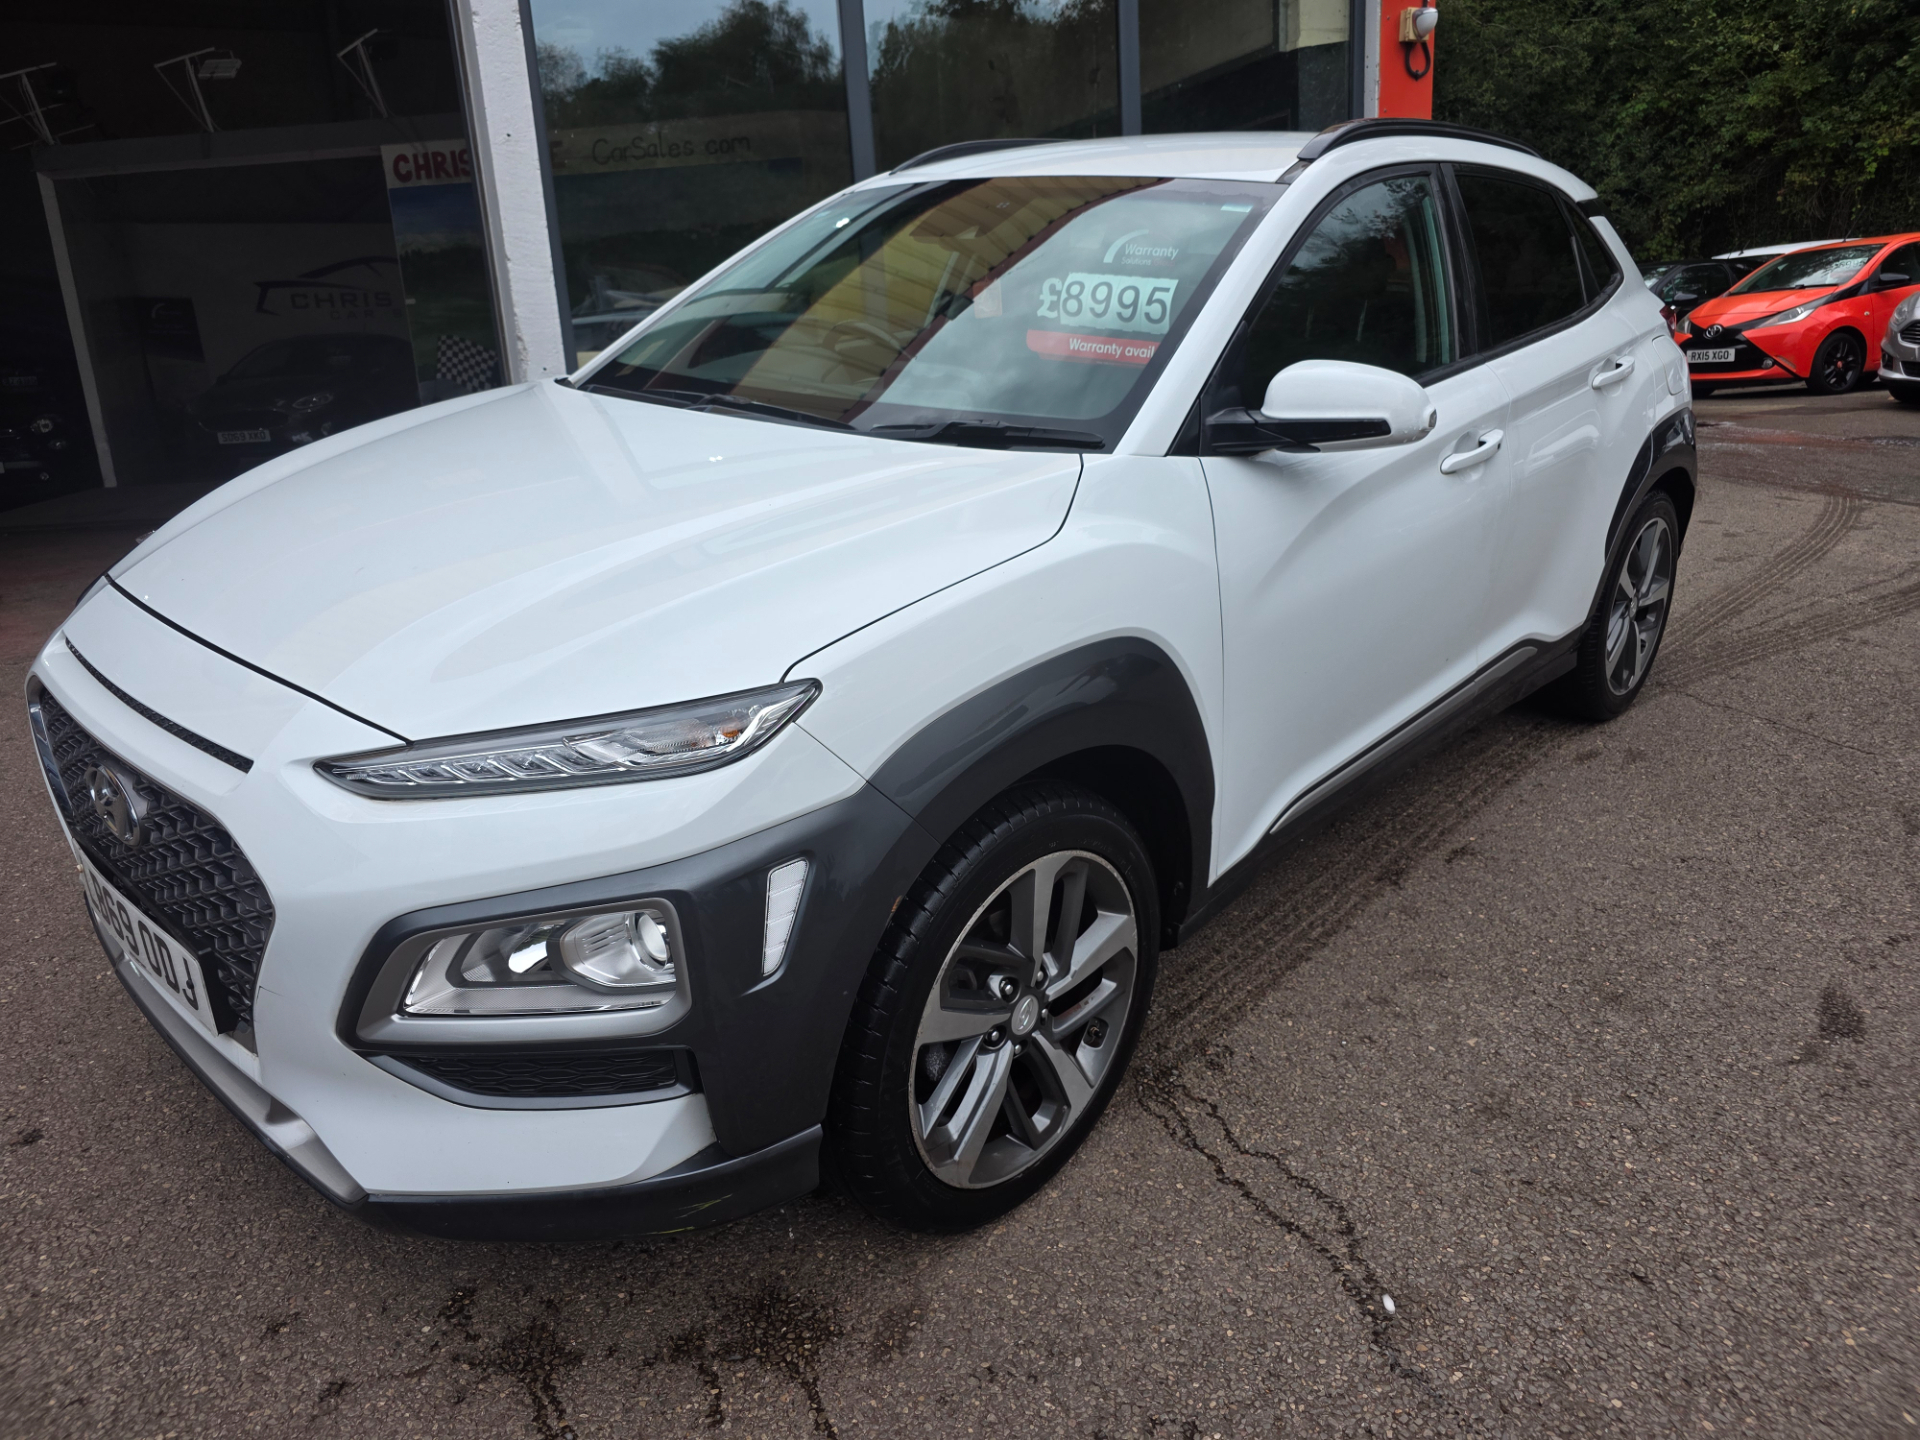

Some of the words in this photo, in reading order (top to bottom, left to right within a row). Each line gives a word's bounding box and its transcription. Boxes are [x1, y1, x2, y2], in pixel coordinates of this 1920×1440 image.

[393, 148, 471, 183] CHRIS
[1125, 243, 1179, 260] Warranty
[290, 291, 392, 309] CHRIS
[1037, 277, 1171, 325] £8995
[1069, 338, 1123, 358] Warranty
[1691, 351, 1710, 361] RX15
